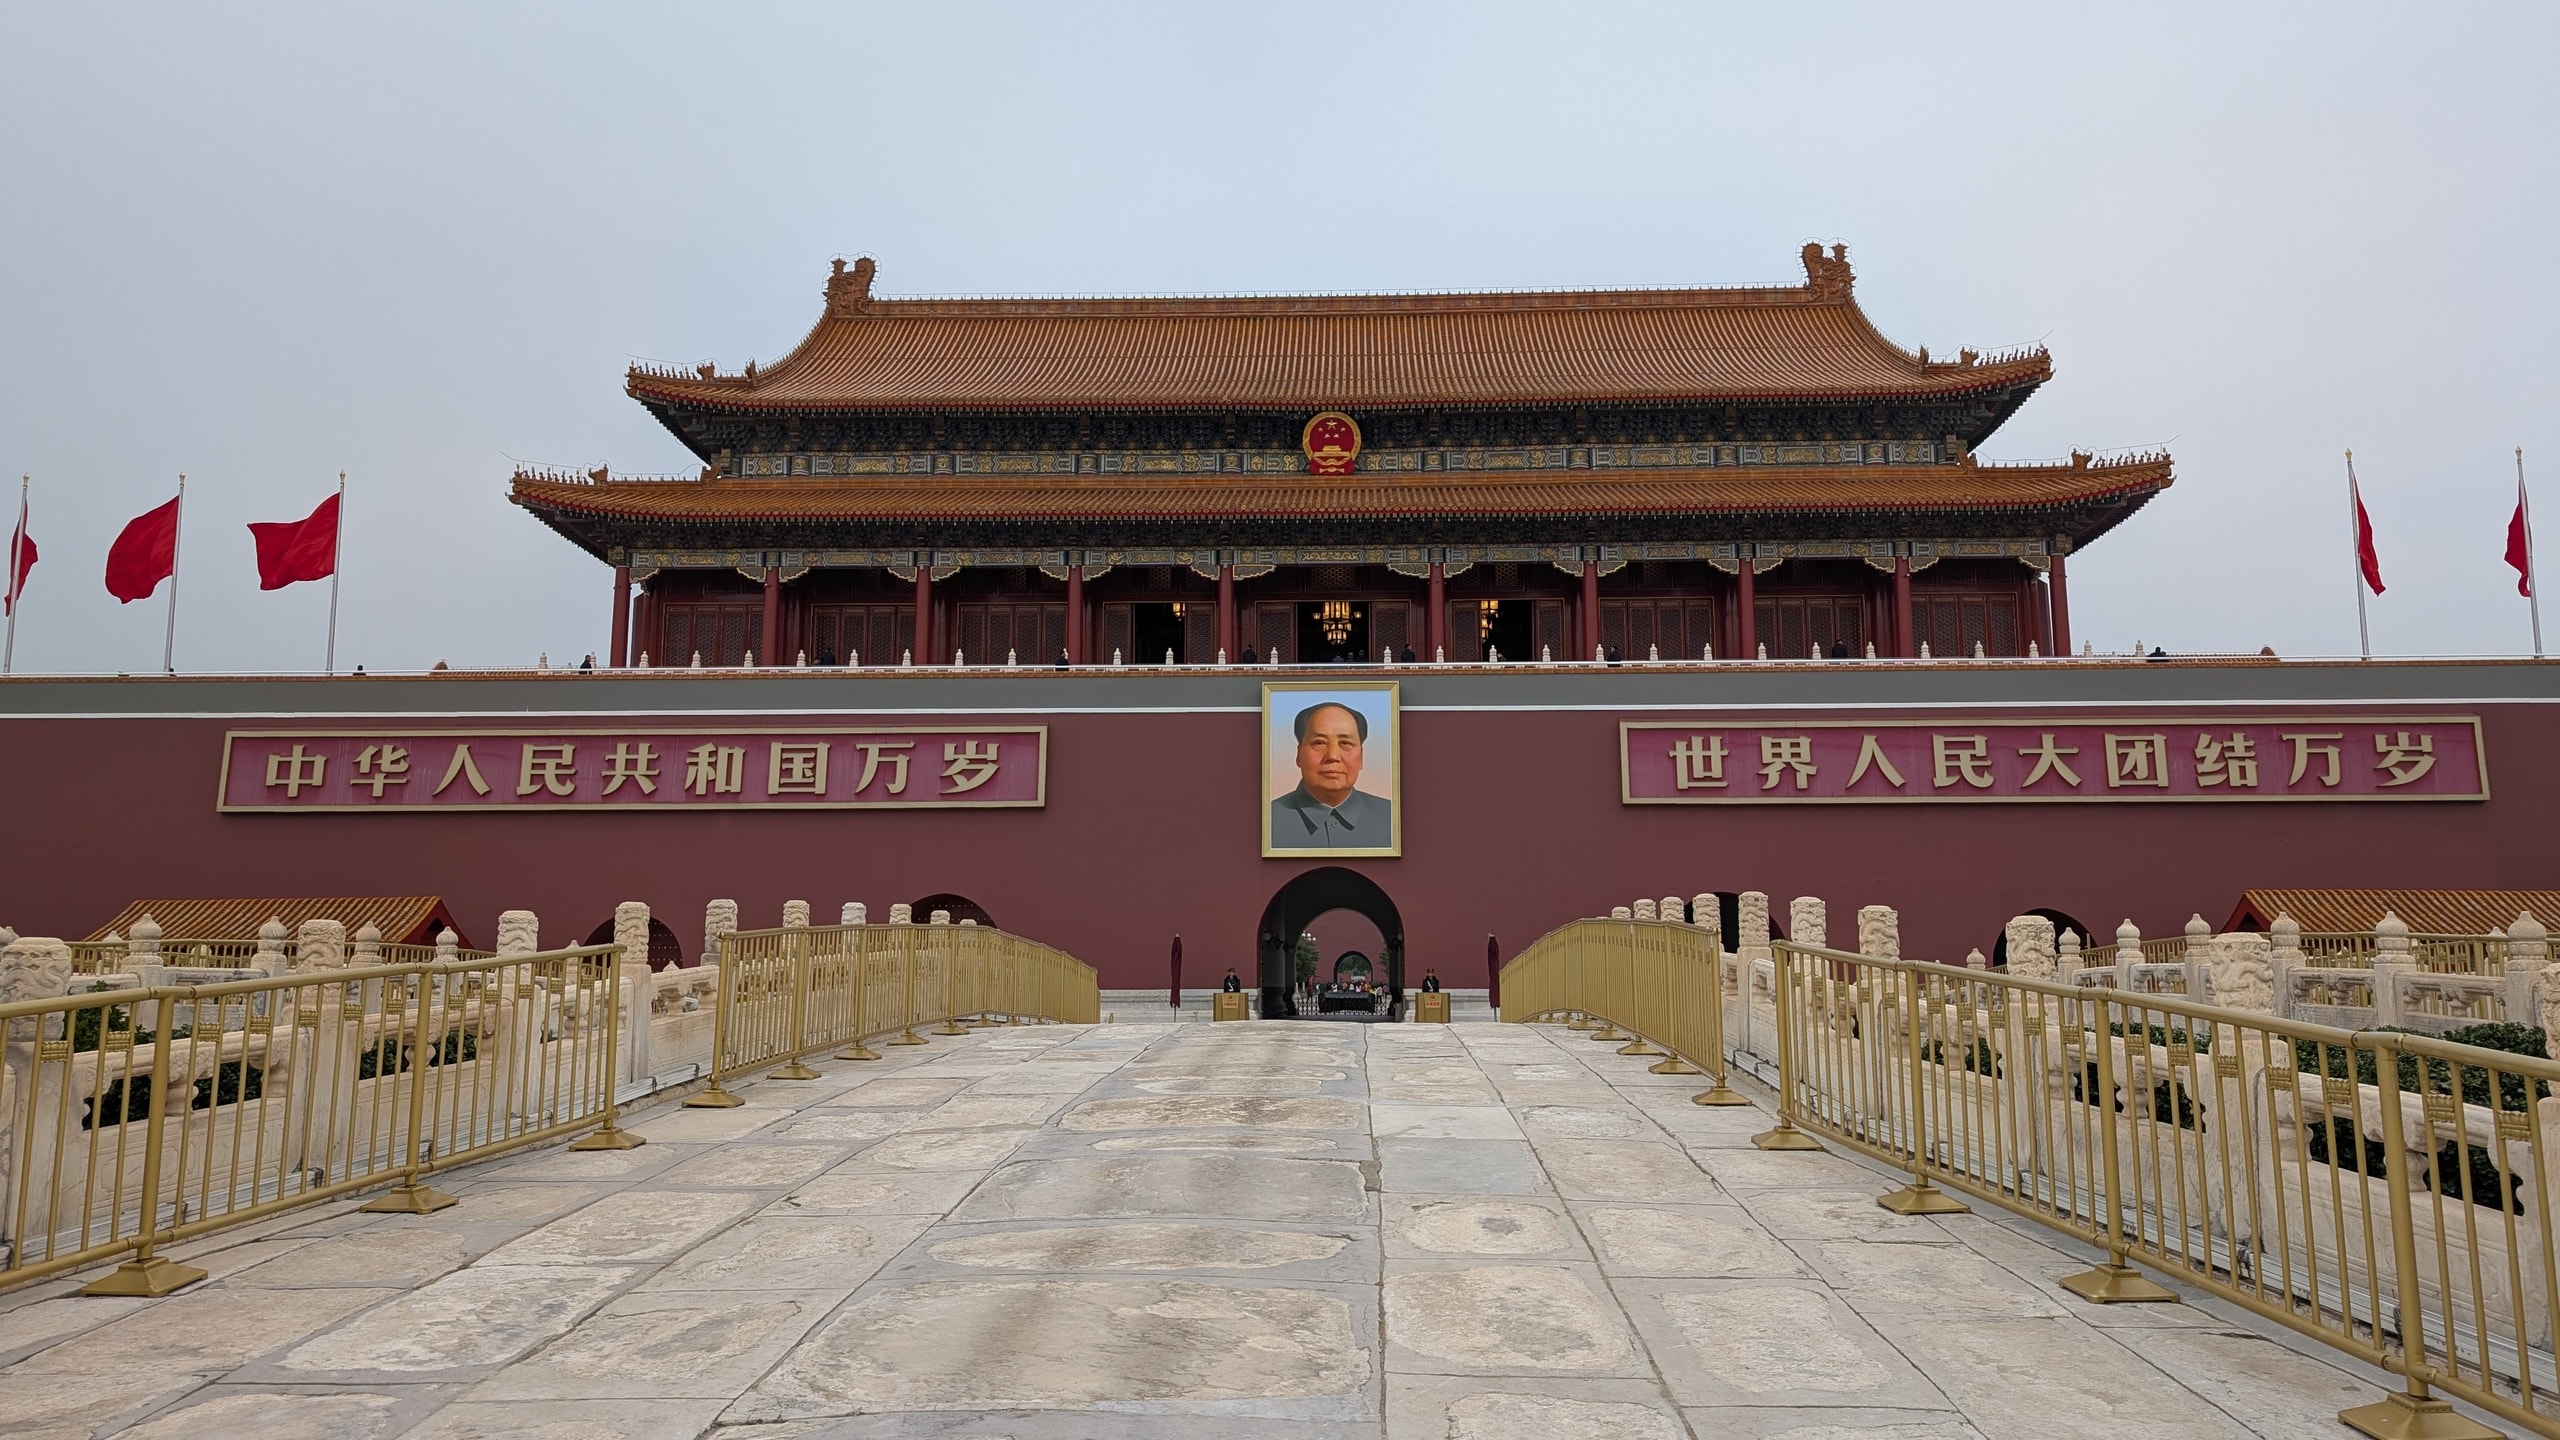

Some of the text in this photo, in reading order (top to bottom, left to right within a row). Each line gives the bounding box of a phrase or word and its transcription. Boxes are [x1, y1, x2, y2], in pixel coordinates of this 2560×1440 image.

[264, 741, 1000, 798] 中华人民共和国万岁
[1668, 731, 2437, 790] 世界人民大团结万岁
